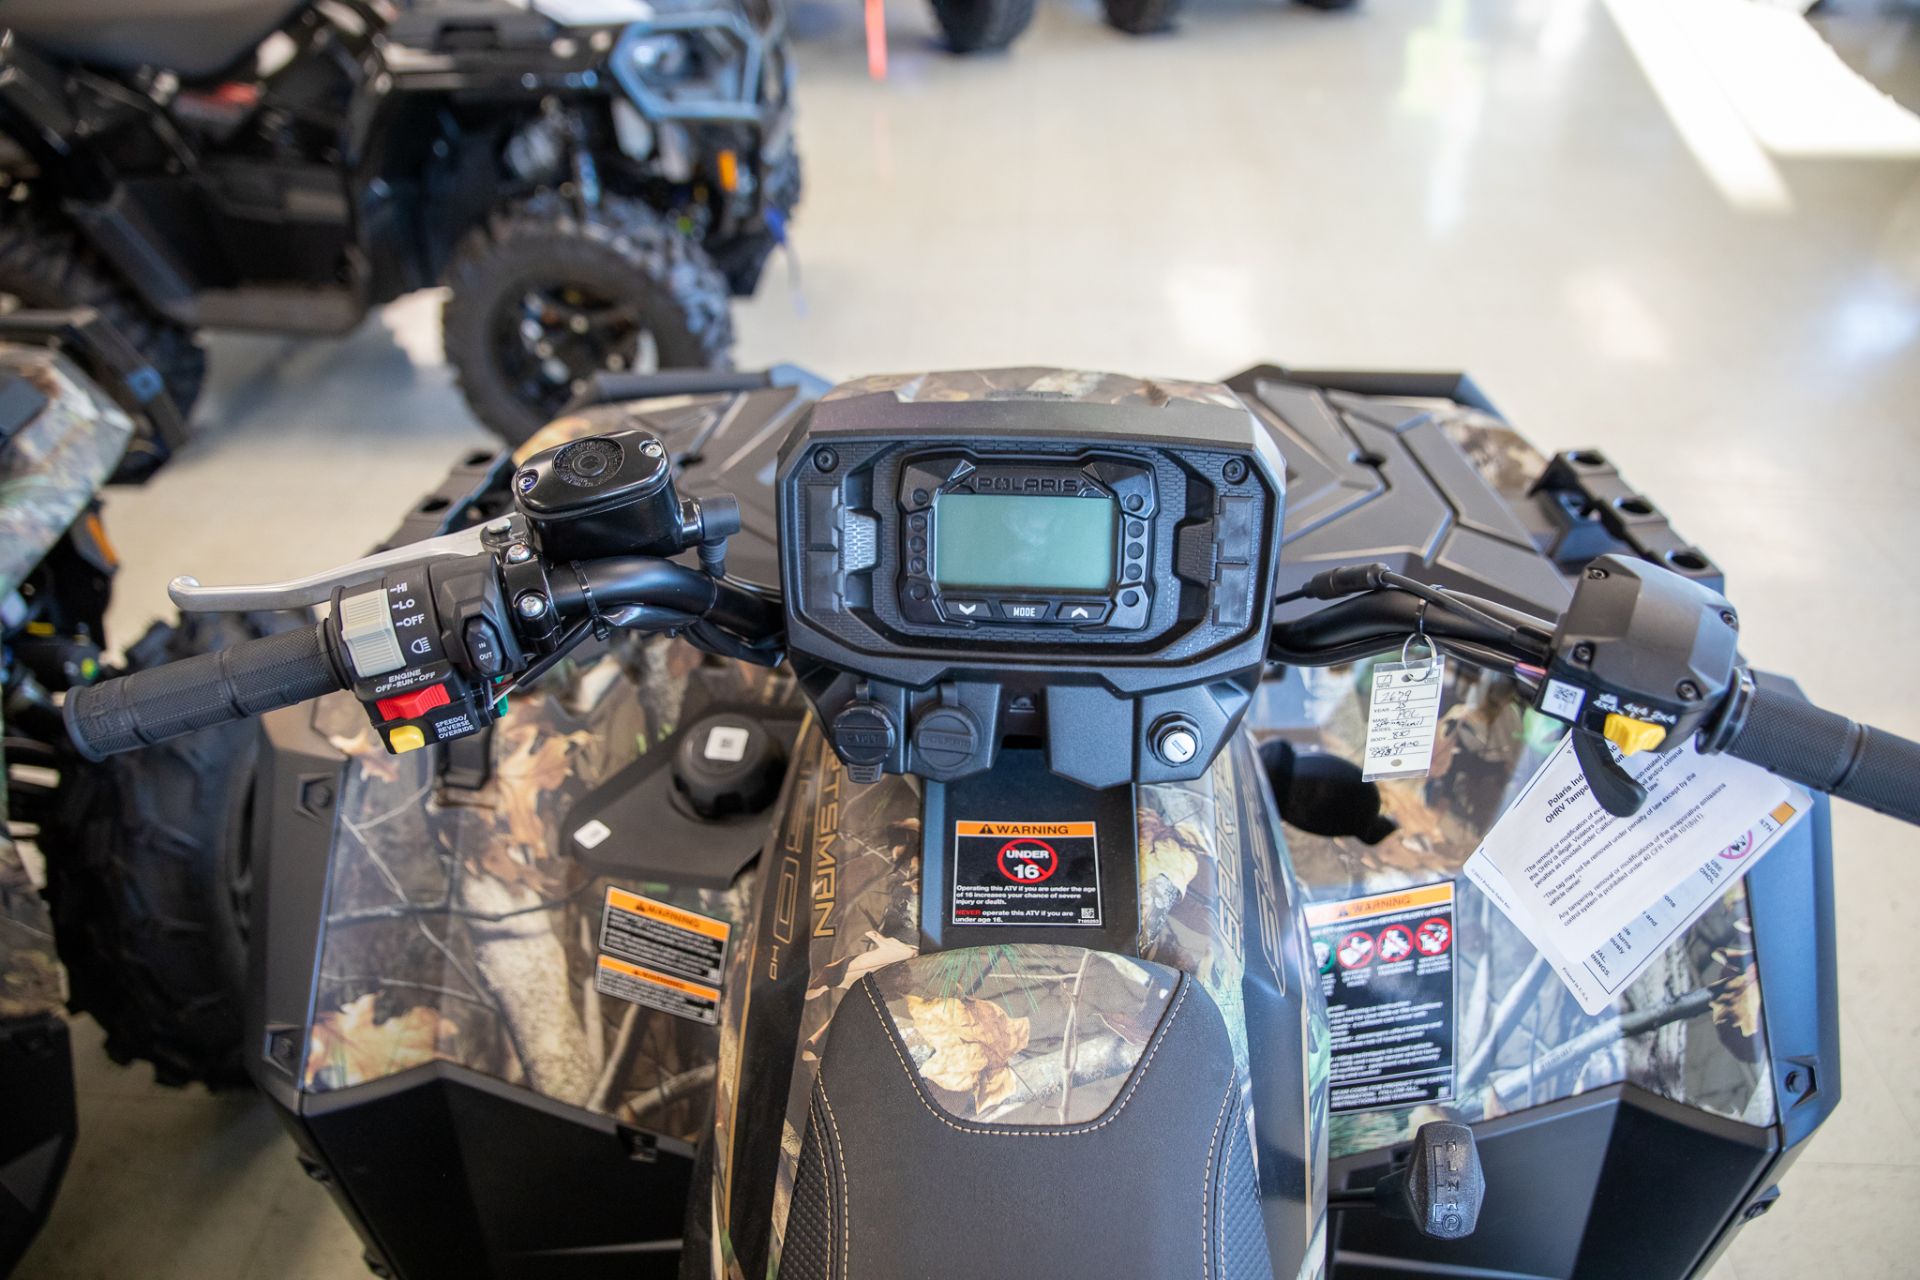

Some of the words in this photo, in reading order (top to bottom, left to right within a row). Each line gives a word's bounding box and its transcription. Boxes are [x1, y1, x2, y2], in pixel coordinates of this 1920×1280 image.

[976, 477, 1077, 491] POLARIS
[1013, 607, 1036, 617] MODE
[402, 613, 425, 627] OFF
[479, 652, 493, 661] OUT
[388, 668, 422, 683] ENGINE
[435, 713, 467, 728] SPEEDO/
[438, 720, 471, 734] REVERSE
[438, 725, 475, 740] OVERRIDE
[1546, 783, 1574, 808] Polaris
[1528, 870, 1539, 881] this
[1536, 857, 1554, 873] OHRV
[1571, 822, 1596, 843] Violators
[1593, 814, 1607, 826] may
[1645, 764, 1664, 781] and/or
[1660, 746, 1684, 767] criminal
[1543, 802, 1567, 824] OHRV
[996, 825, 1069, 834] WARNING
[1554, 880, 1566, 891] tag
[1563, 872, 1576, 884] may
[1573, 864, 1584, 874] not
[1581, 858, 1591, 867] be
[1588, 840, 1613, 861] removed
[1610, 828, 1628, 844] under
[1625, 812, 1648, 832] penalty
[1644, 806, 1654, 816] of
[1650, 799, 1663, 811] law
[1660, 784, 1681, 803] except
[1677, 778, 1688, 789] by
[1685, 771, 1697, 782] the
[1533, 846, 1555, 865] removal
[1557, 817, 1589, 845] modification
[1586, 812, 1594, 820] of
[1006, 850, 1049, 859] UNDER
[1532, 867, 1556, 888] penalties
[1554, 862, 1562, 870] as
[1559, 844, 1582, 865] provided
[1580, 832, 1597, 847] under
[1557, 908, 1570, 920] Any
[1592, 871, 1614, 891] removal
[1612, 867, 1621, 875] or
[1618, 839, 1655, 870] modifications
[1651, 834, 1661, 844] of
[1658, 827, 1670, 838] the
[1668, 803, 1701, 832] evaporative
[1013, 864, 1040, 879] 16
[1562, 909, 1582, 927] control
[1601, 870, 1630, 896] prohibited
[1626, 859, 1644, 875] under
[1641, 852, 1652, 863] 40
[1649, 842, 1665, 857] CFR
[1352, 895, 1412, 911] WARNING
[1547, 889, 1566, 906] vehicle
[1644, 911, 1659, 928] and
[1615, 931, 1633, 950] turns
[1447, 1160, 1458, 1172] L
[1447, 1217, 1458, 1231] P
